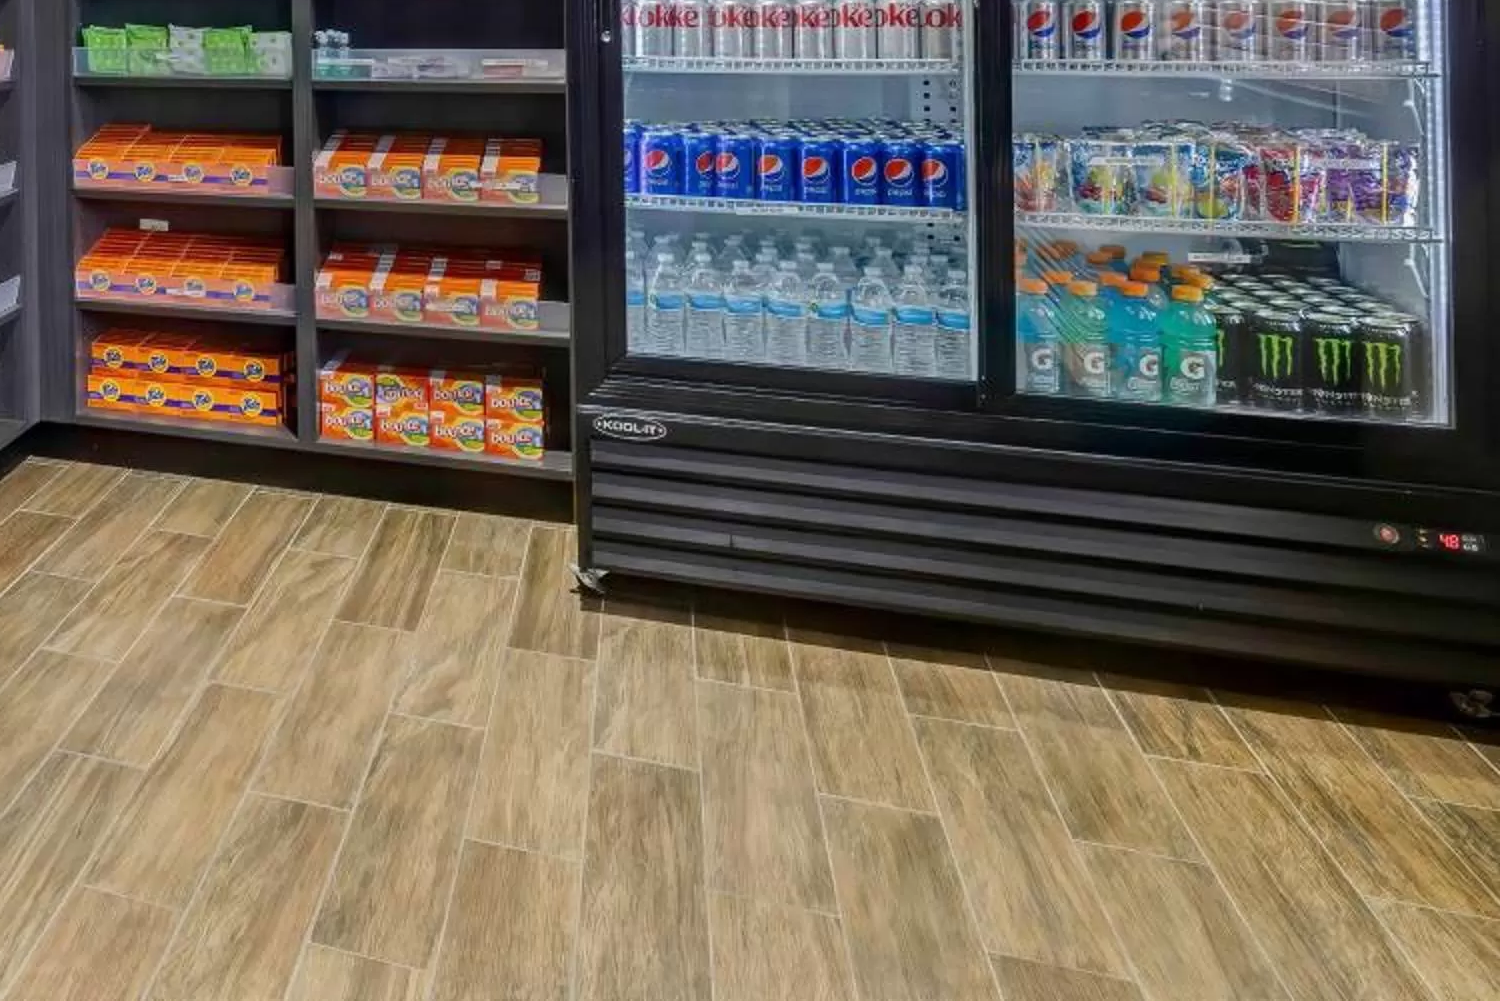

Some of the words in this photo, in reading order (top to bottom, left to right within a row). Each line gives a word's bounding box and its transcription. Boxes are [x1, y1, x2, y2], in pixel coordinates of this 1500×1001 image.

[1031, 348, 1053, 369] G
[1083, 352, 1105, 374] G
[1139, 355, 1159, 376] G
[1180, 356, 1205, 379] G
[1438, 534, 1460, 550] 48
